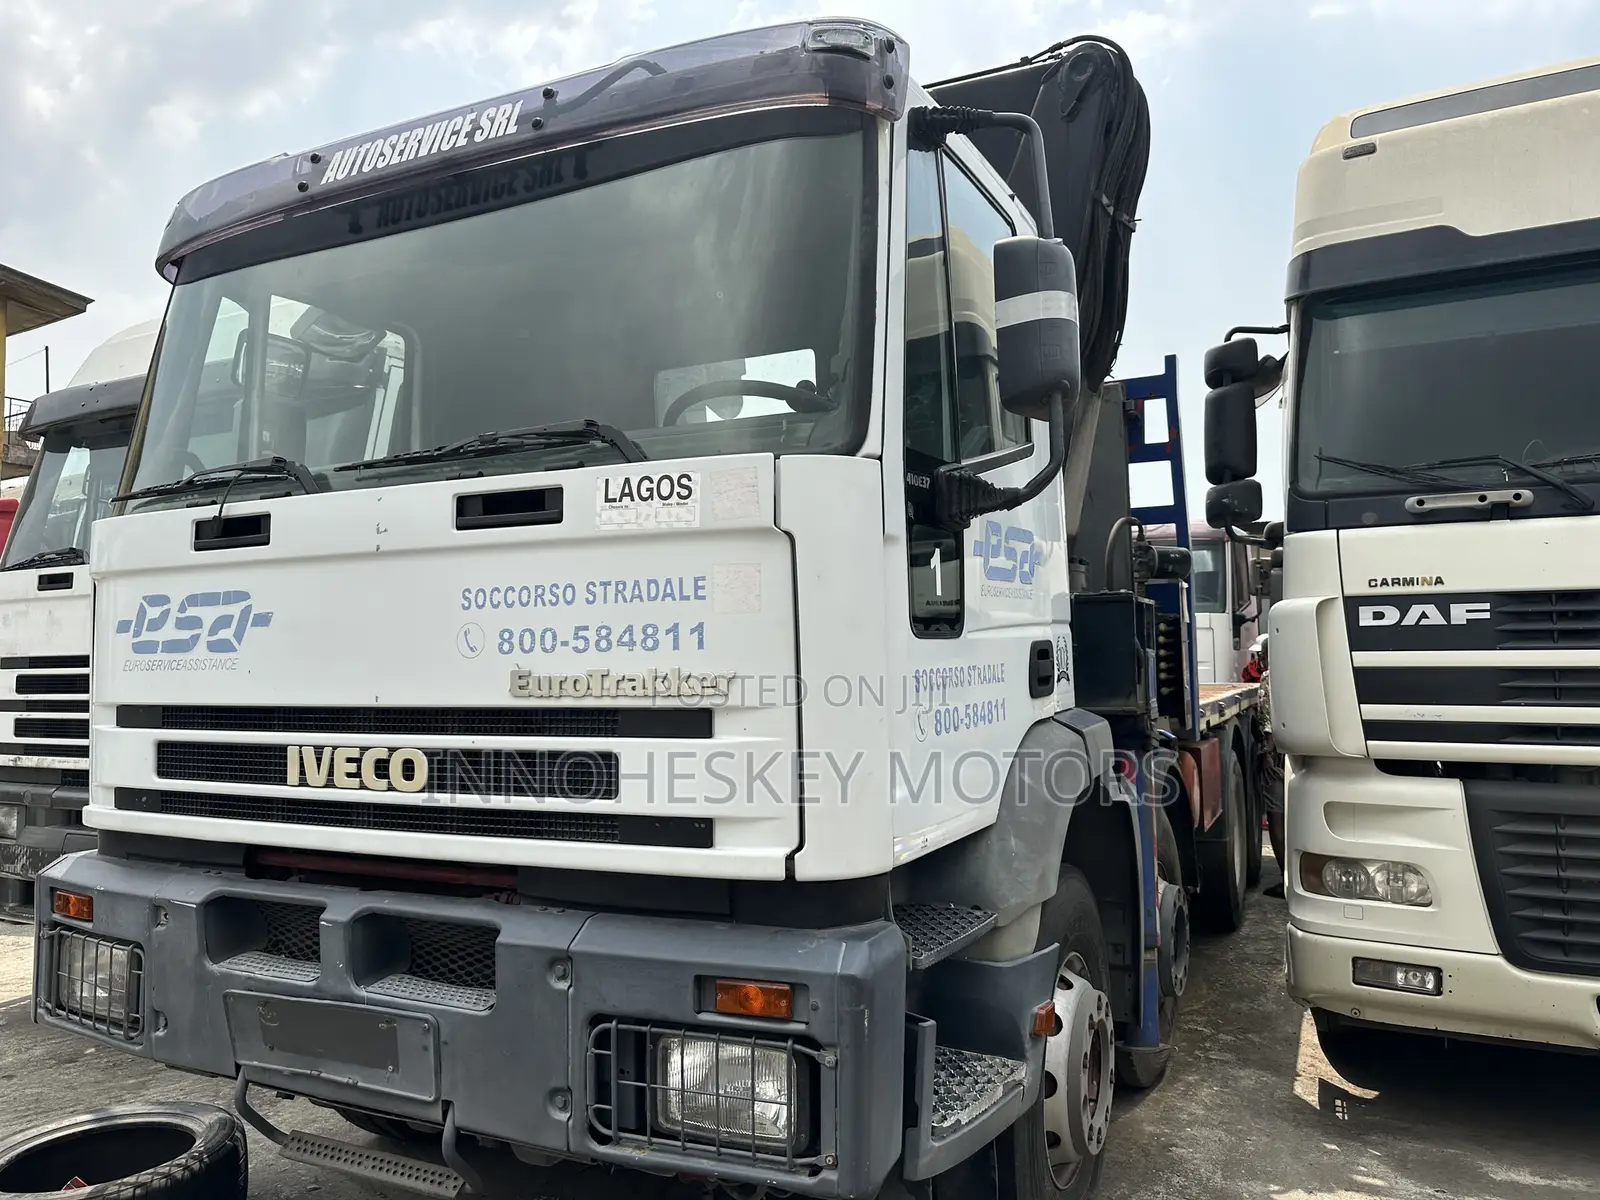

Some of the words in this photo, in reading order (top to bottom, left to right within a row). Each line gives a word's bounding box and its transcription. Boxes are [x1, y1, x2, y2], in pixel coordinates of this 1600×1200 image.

[320, 110, 477, 186] AUTOSERVICE
[475, 100, 523, 142] SRL
[604, 473, 693, 503] LAGOS
[930, 547, 942, 596] 1
[1368, 576, 1445, 588] CARMINA
[461, 582, 576, 611] SOCCORSO
[584, 576, 707, 605] STRADALE
[1358, 602, 1491, 627] DAF
[497, 621, 706, 655] 800-584811
[123, 657, 239, 672] EUROSERVICEASSISTANCE
[914, 667, 965, 693] SOCCORSO
[967, 663, 1005, 686] STRADALE
[509, 665, 736, 698] EuroTrakker
[934, 698, 1006, 736] 800-584811
[286, 745, 428, 792] IVECO
